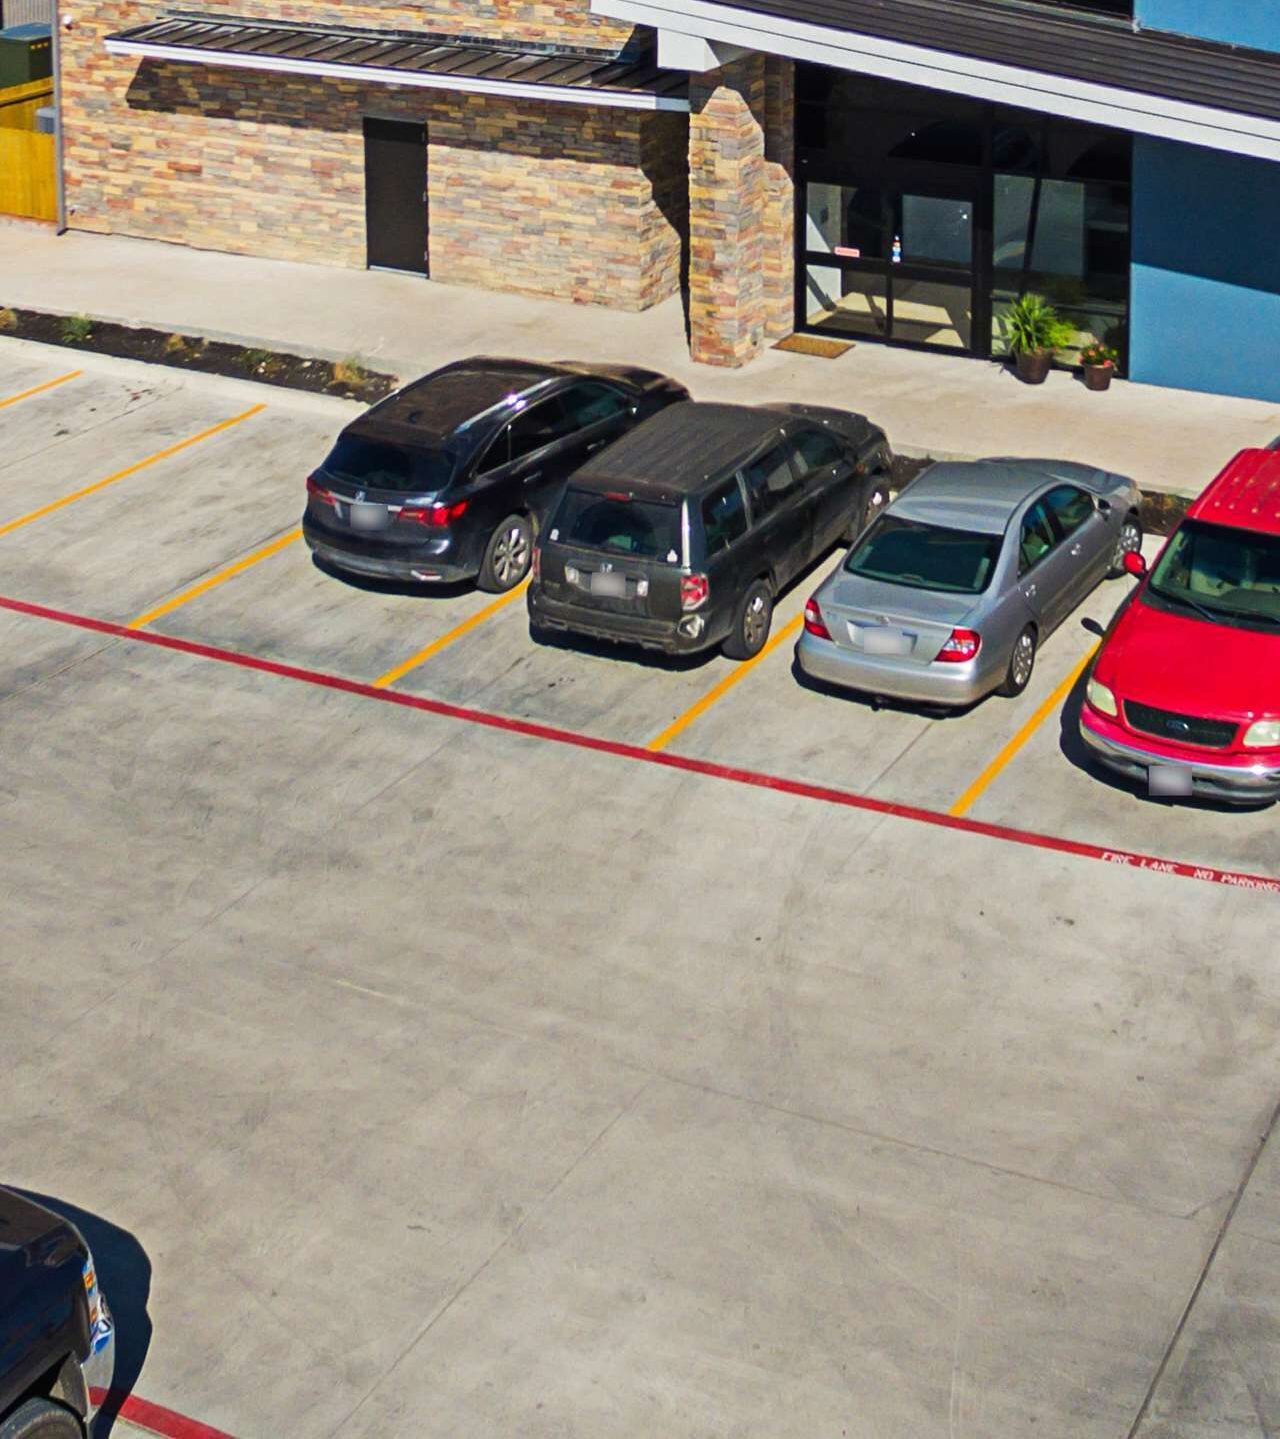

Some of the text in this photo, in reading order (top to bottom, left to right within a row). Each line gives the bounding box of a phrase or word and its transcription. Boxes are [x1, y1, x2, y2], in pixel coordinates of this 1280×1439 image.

[1102, 851, 1135, 865] FIRE
[1140, 858, 1178, 874] LANE
[1193, 868, 1214, 881] NO
